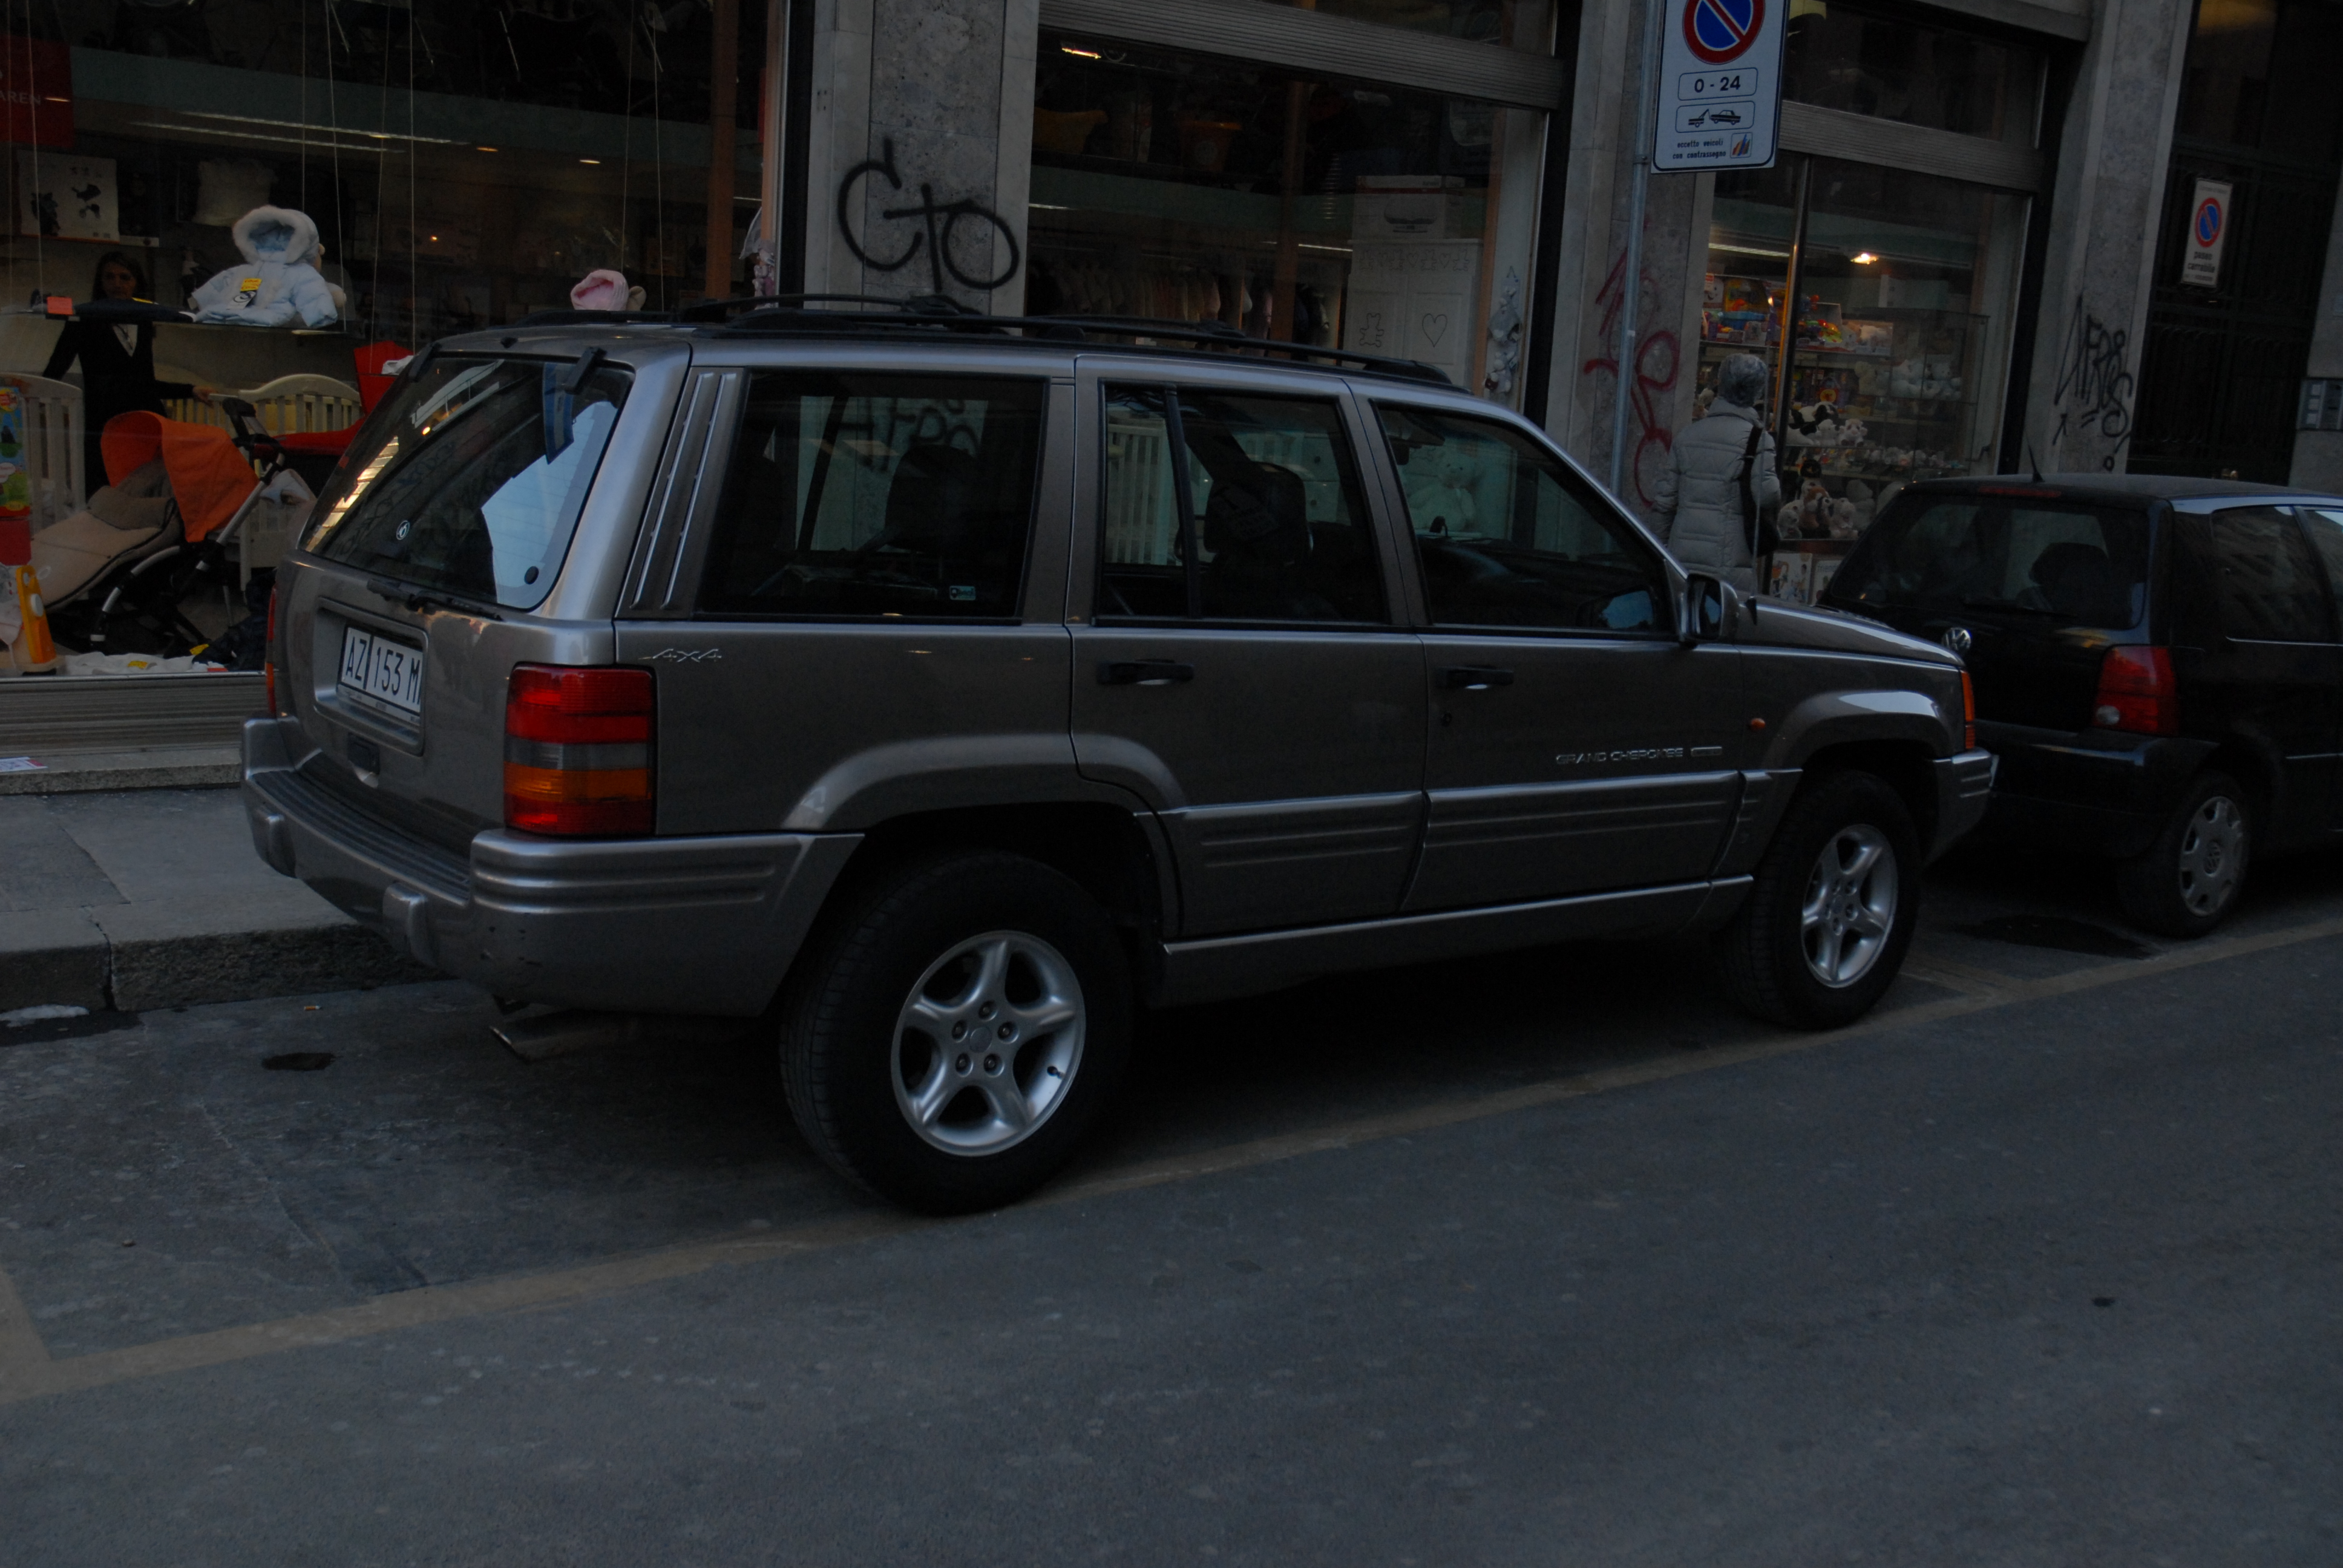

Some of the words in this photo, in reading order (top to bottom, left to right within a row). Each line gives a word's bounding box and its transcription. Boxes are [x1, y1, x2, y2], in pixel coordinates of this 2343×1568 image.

[1694, 78, 1705, 93] 0
[1719, 75, 1741, 91] 24
[1677, 140, 1700, 148] eccetto
[1703, 138, 1724, 147] veicoli
[1686, 150, 1726, 159] contrassegno
[346, 636, 367, 681] AZ
[374, 646, 404, 695] 153
[407, 657, 422, 705] M
[1556, 752, 1607, 764] GRAND
[1610, 747, 1684, 761] CHEROKEE
